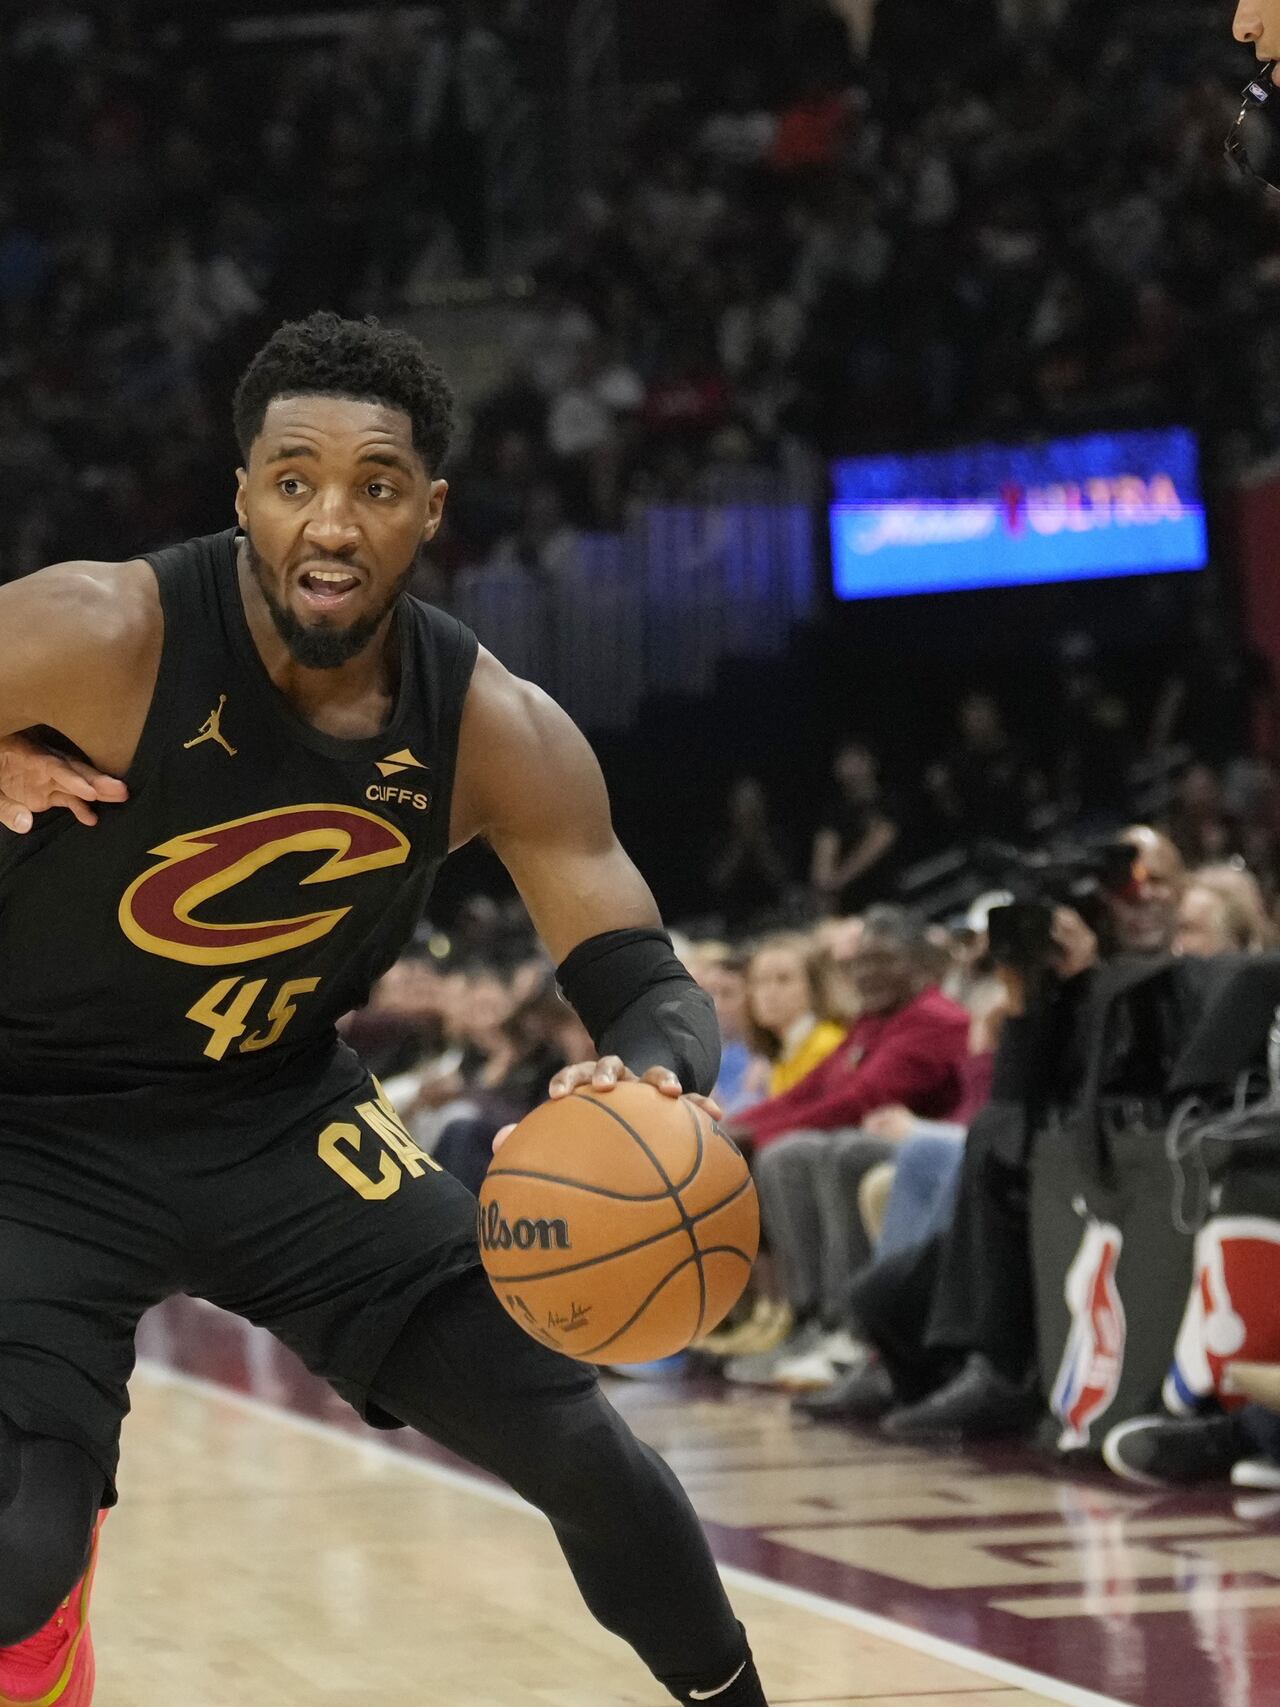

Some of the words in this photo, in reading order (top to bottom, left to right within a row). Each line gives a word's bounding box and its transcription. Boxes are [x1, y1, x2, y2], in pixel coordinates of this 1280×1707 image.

[118, 803, 411, 966] C
[185, 975, 322, 1061] 45
[480, 1199, 572, 1250] ilson
